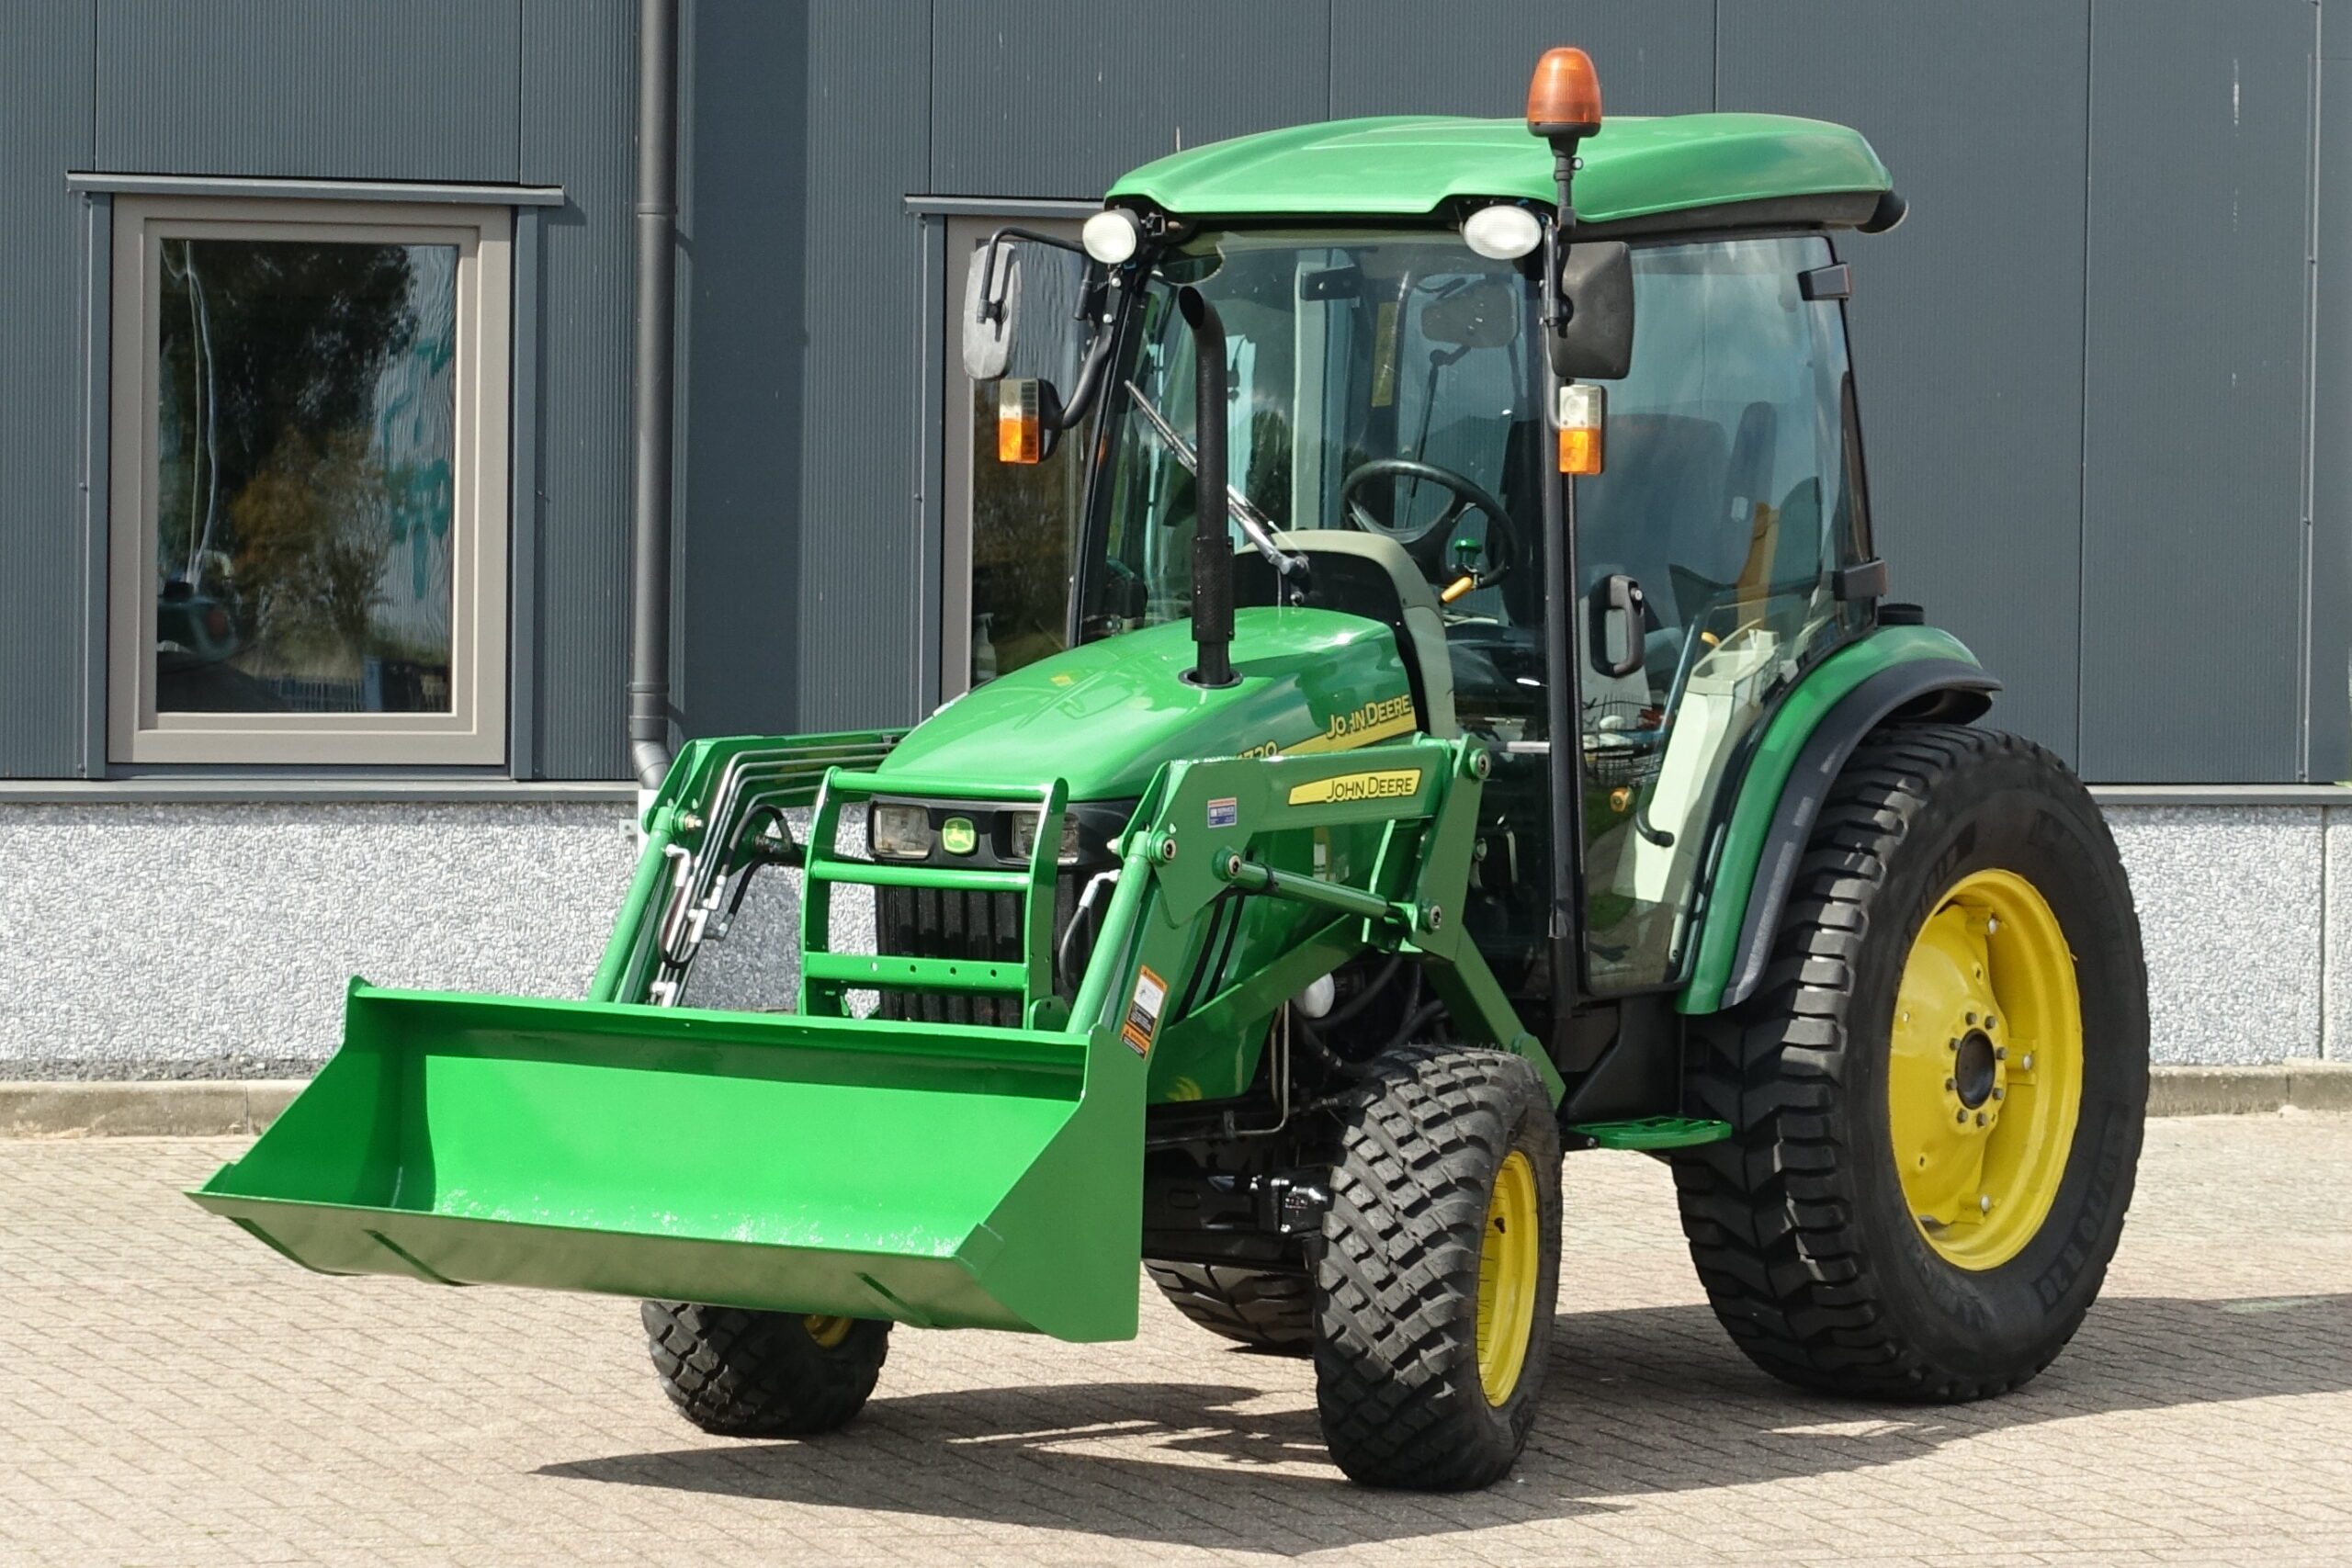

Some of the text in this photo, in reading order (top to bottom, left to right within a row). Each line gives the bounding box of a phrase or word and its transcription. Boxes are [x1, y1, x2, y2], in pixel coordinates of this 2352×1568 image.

[1327, 694, 1411, 739] JOHN DEERE
[1237, 739, 1278, 759] 20
[1327, 777, 1413, 799] JOHN DEERE
